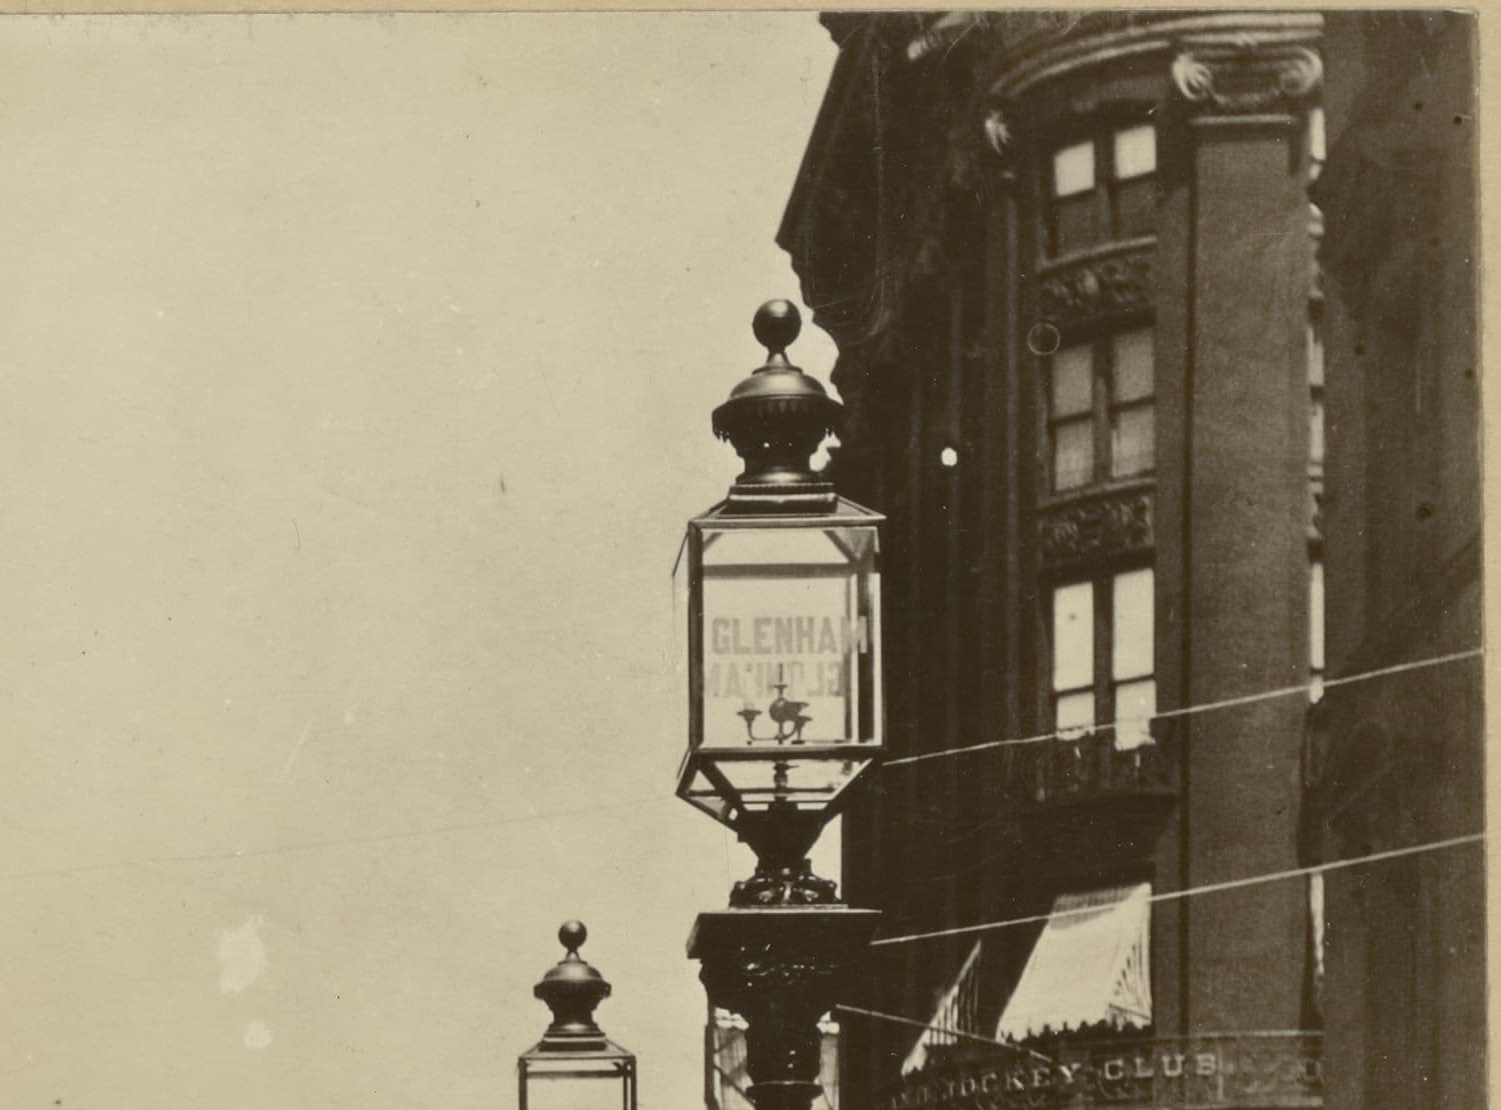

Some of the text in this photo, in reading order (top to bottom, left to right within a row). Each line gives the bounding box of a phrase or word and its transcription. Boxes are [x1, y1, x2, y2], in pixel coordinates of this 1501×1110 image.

[712, 617, 867, 654] GLENHAM
[940, 1052, 1217, 1101] JOCKEY CLUB
